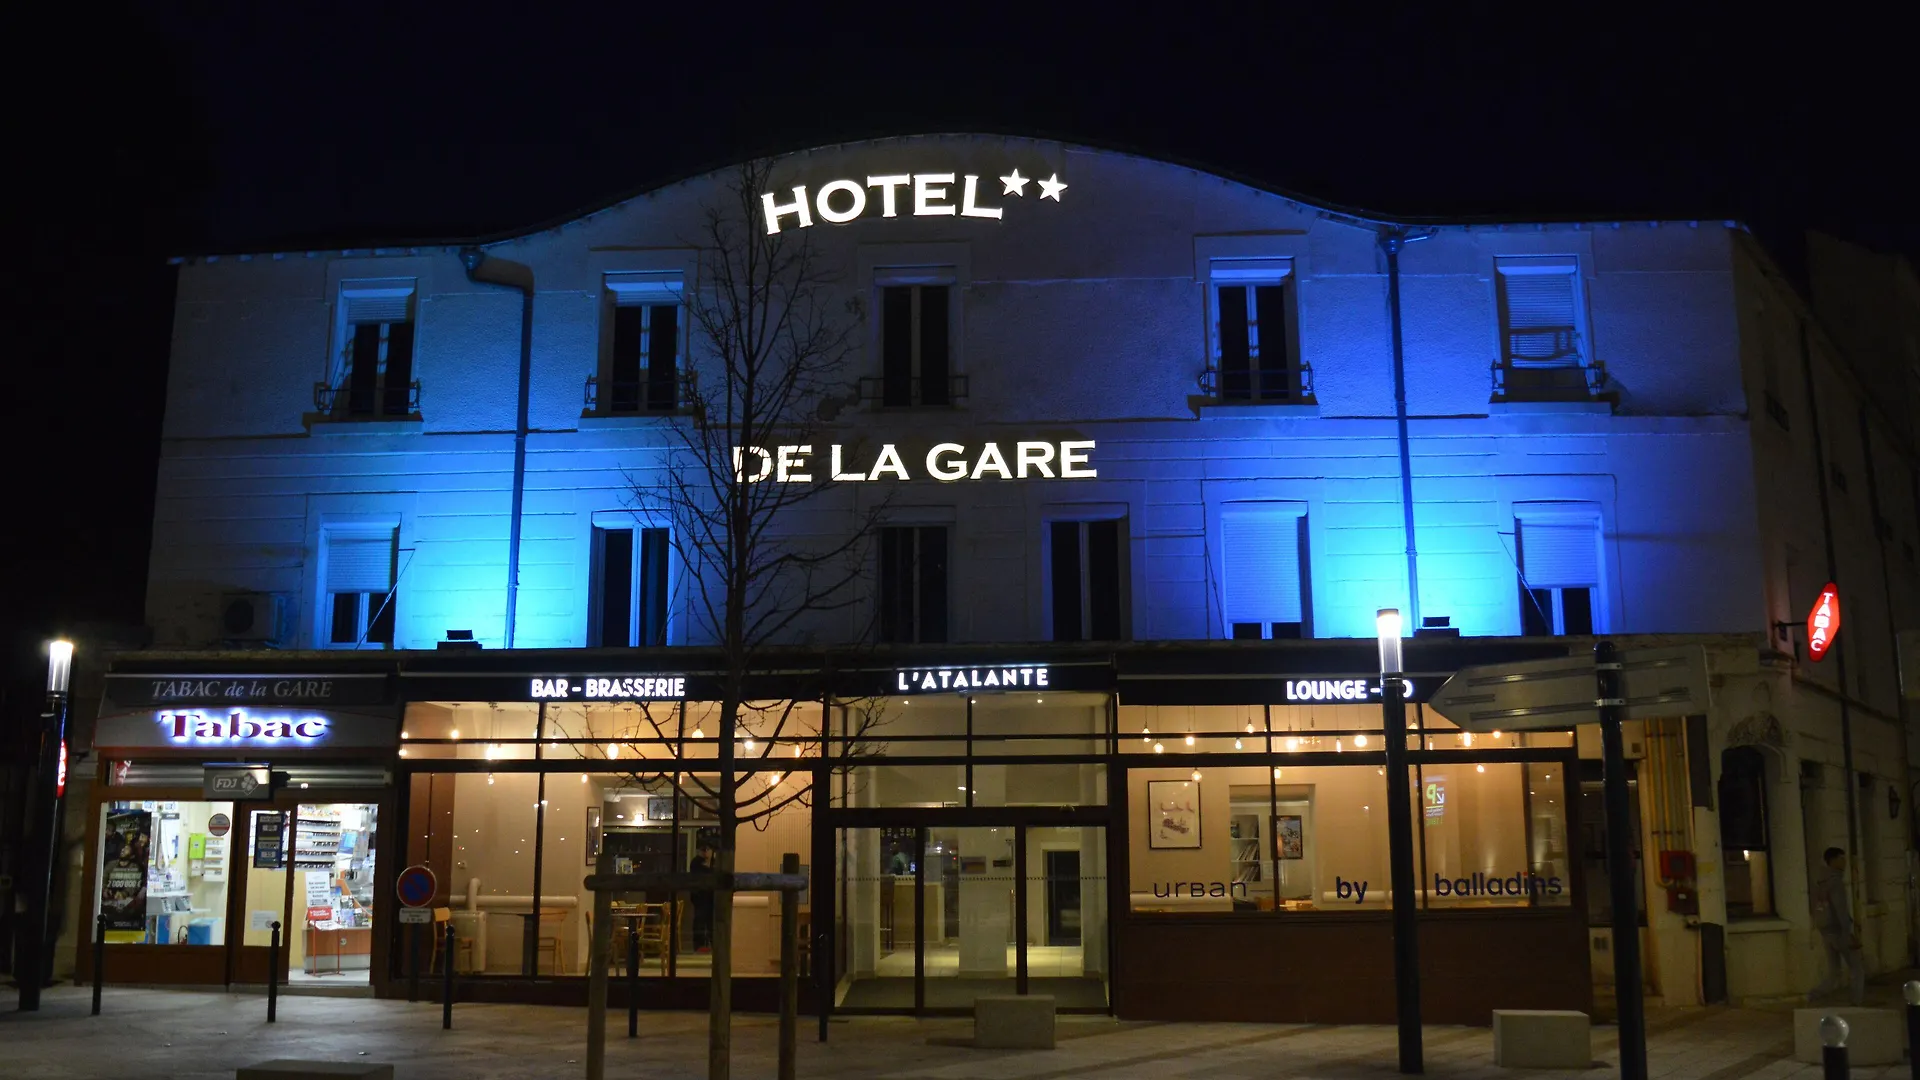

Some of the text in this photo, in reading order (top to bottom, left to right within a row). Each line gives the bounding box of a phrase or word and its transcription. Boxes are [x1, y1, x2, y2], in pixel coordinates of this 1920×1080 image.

[761, 172, 1003, 235] HOTEL
[733, 440, 1097, 483] DE LA GARE
[1811, 592, 1833, 651] TABAC
[152, 680, 333, 698] TABAC de la GARE
[531, 678, 568, 698] BAR
[585, 678, 685, 698] BRASSERIE
[898, 668, 1049, 692] L'ATALANTE
[1286, 679, 1368, 700] LOUNGE
[160, 709, 334, 741] Tabac
[216, 778, 238, 789] FDJ
[1335, 875, 1369, 905] by
[1434, 871, 1563, 897] balladins
